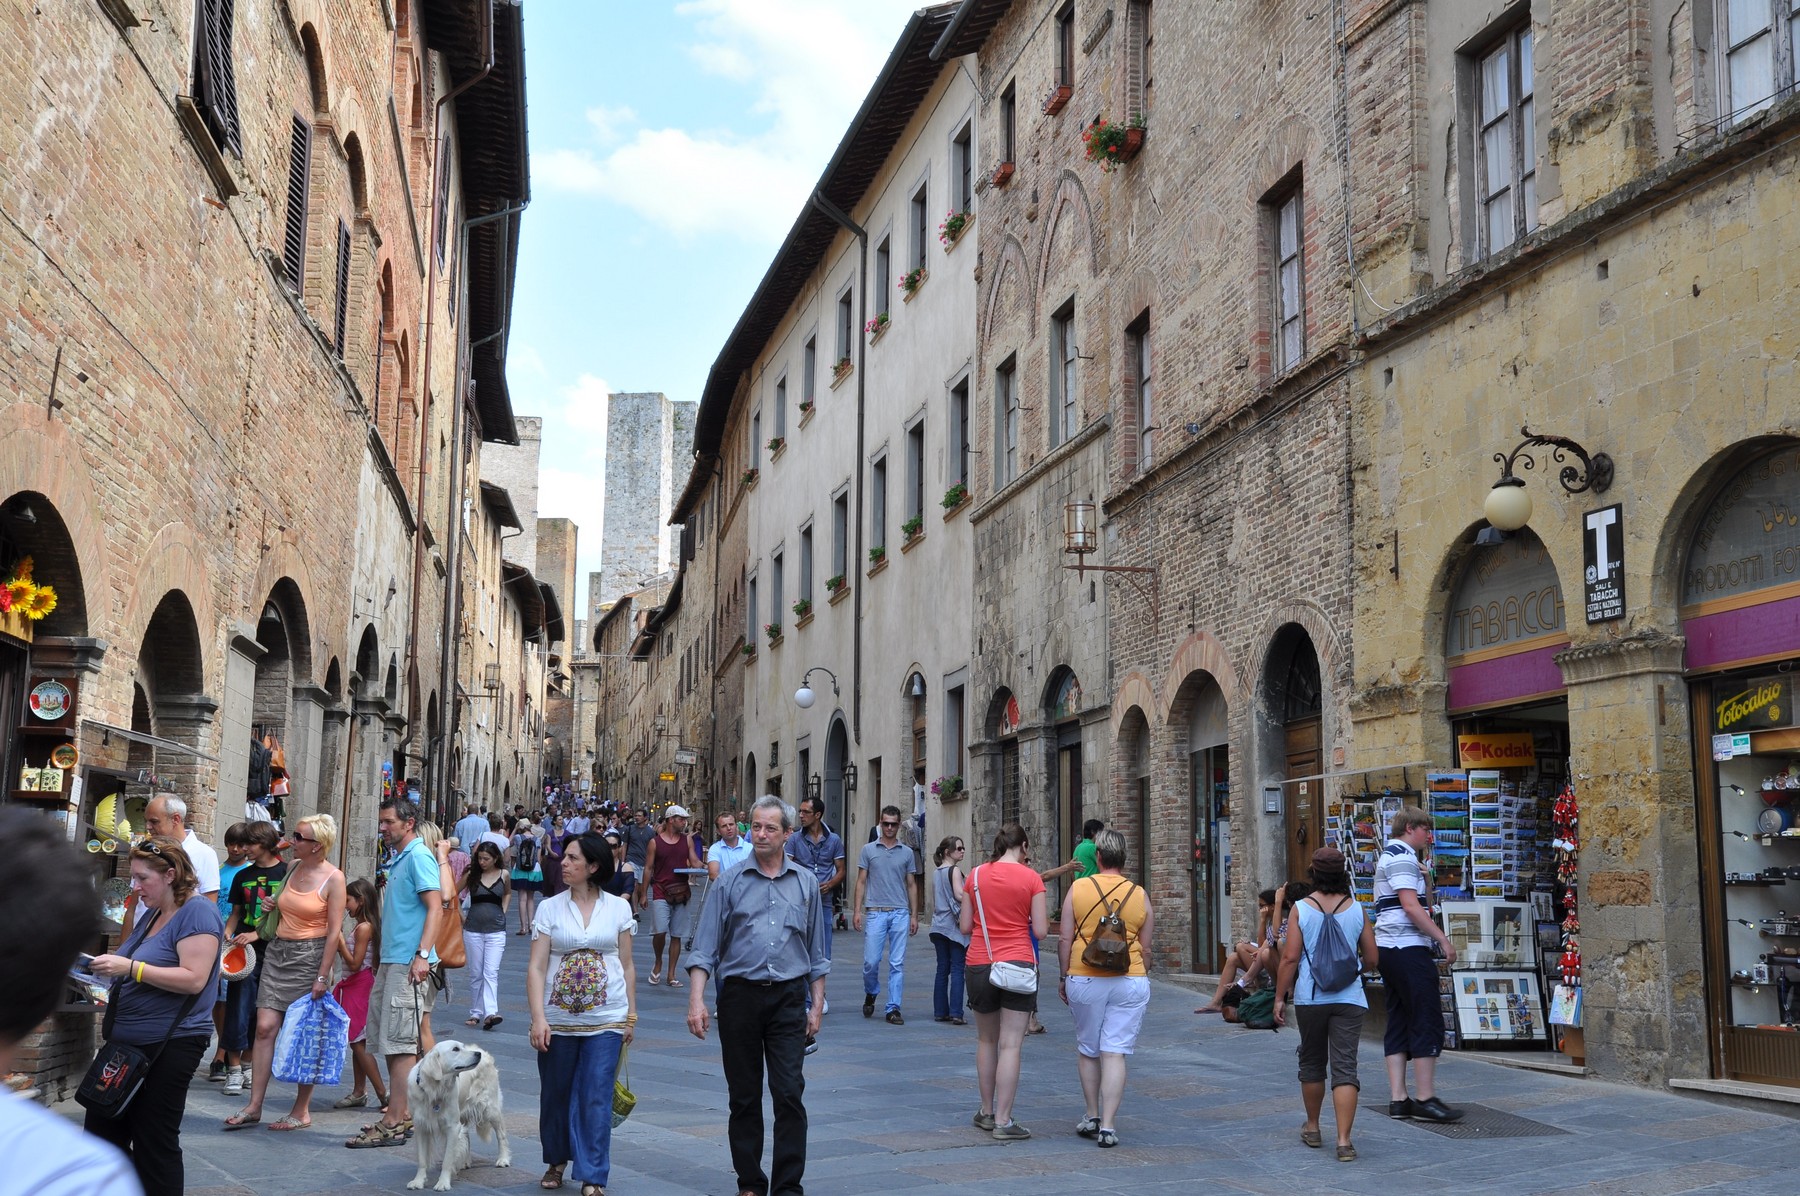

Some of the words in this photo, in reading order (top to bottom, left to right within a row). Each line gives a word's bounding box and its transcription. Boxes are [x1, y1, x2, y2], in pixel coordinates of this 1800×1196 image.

[1586, 507, 1616, 580] T
[1687, 554, 1763, 596] PRODOTTI
[1590, 588, 1618, 602] TABACCHI
[1595, 583, 1606, 591] SALI
[1604, 607, 1621, 618] BOLLATI
[1716, 682, 1782, 729] Totocalcio
[1482, 742, 1533, 759] Kodak
